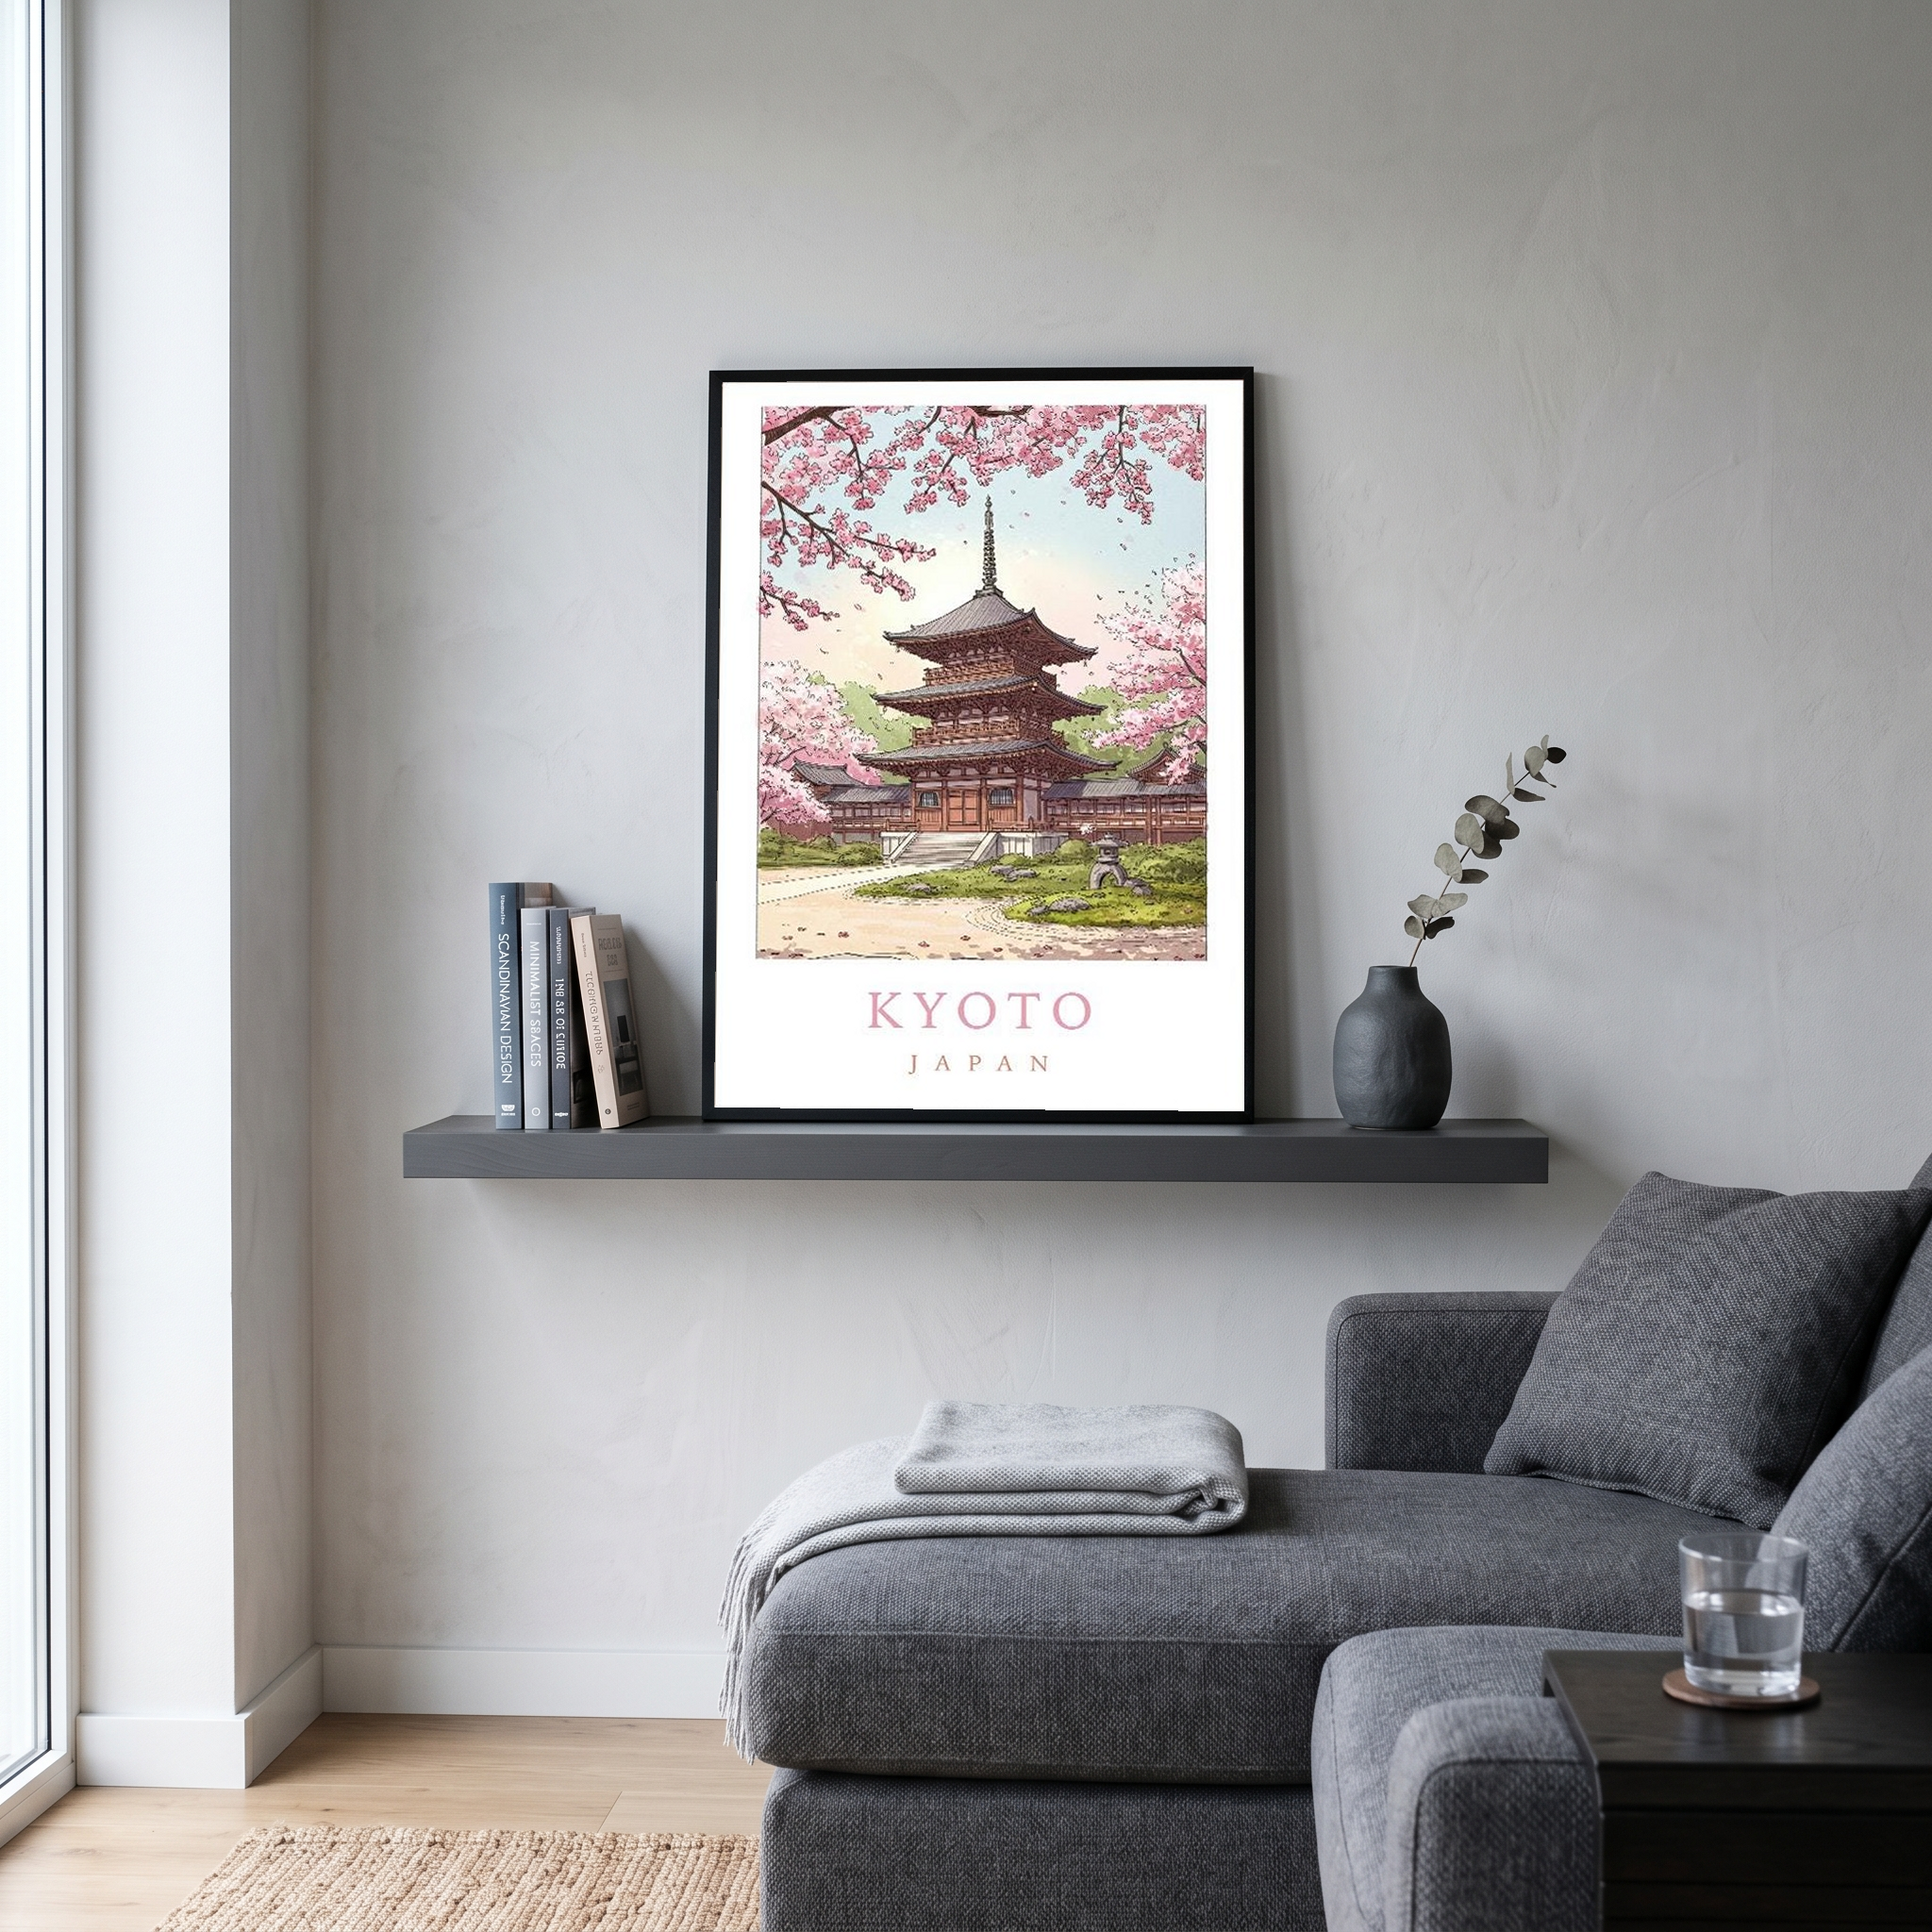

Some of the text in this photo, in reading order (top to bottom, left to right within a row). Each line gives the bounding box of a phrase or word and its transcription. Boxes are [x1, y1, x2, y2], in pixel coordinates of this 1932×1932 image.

[498, 933, 511, 1031] SCANDINAVIAN
[529, 941, 541, 1015] MINIMALIST
[868, 991, 1091, 1030] KYOTO
[500, 1036, 512, 1083] DESIGN
[908, 1055, 1047, 1074] JAPAN
